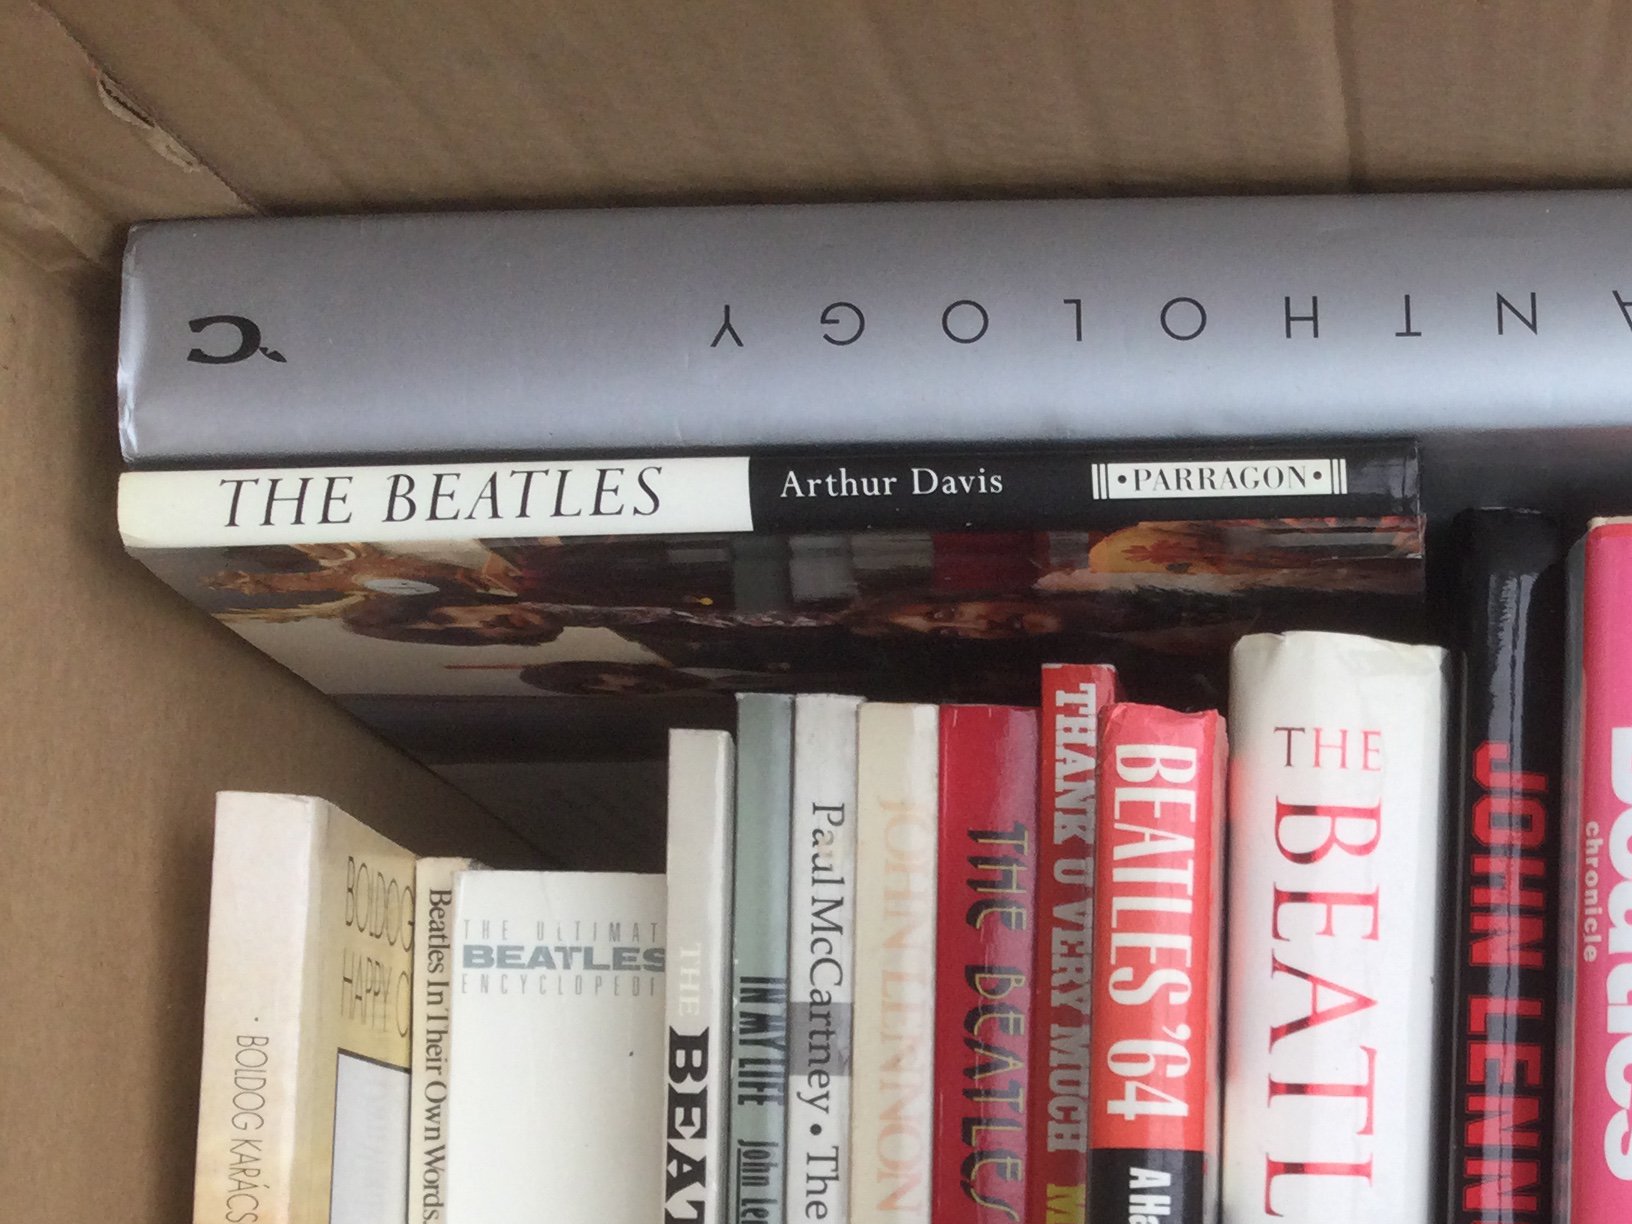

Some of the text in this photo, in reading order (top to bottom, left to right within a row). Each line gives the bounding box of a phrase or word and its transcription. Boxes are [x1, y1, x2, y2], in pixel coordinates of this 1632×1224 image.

[218, 463, 664, 529] THE BEATLES
[780, 465, 1005, 499] Arthur Davis
[1053, 683, 1096, 844] THANK
[1273, 727, 1382, 771] THE
[810, 802, 845, 885] Paul
[1053, 857, 1094, 885] U
[1109, 744, 1197, 1005] BEATLES
[1467, 741, 1547, 970] JOHN
[464, 919, 508, 940] THE
[1582, 821, 1602, 962] chronicle
[463, 945, 665, 972] BEATLES
[679, 943, 701, 1016] THE
[1052, 899, 1093, 1016] VERY
[737, 976, 787, 1106] IN MY LIFE
[796, 896, 844, 1114] McCartney
[422, 889, 452, 1224] Beatles In Their Own Words.
[1047, 1023, 1089, 1151] MUCH
[738, 1139, 778, 1186] John
[804, 1146, 840, 1220] The
[1129, 1168, 1171, 1188] A
